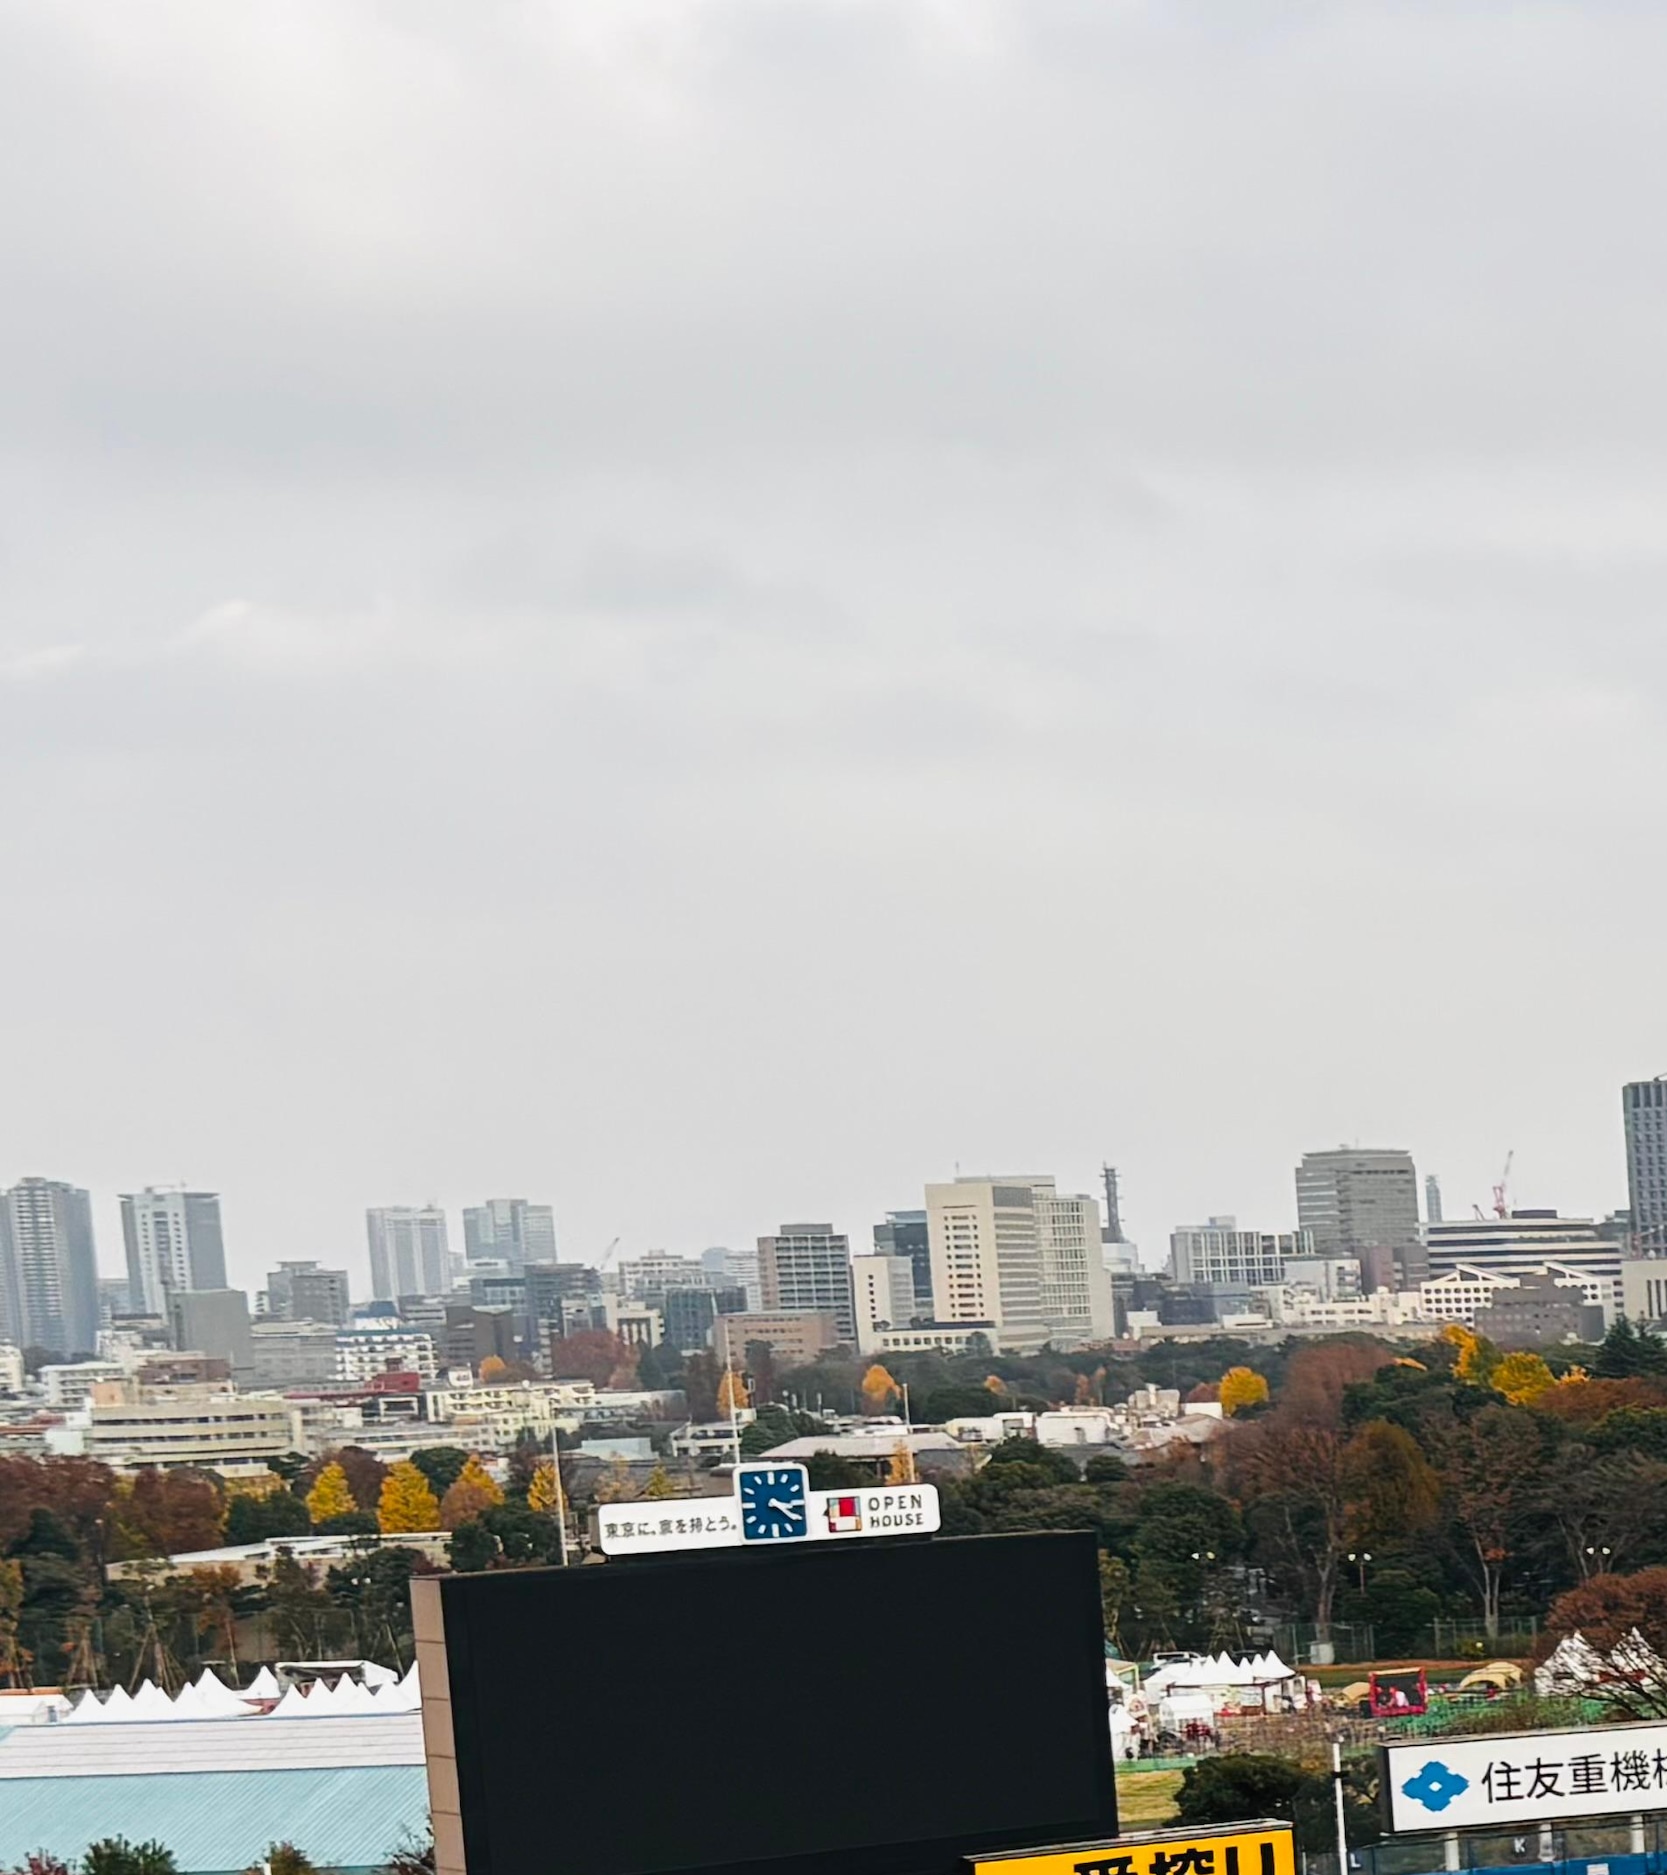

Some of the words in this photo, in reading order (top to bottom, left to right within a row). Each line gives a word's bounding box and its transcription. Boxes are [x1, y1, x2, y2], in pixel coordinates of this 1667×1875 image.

[868, 1494, 923, 1512] OPEN
[870, 1511, 925, 1528] HOUSE
[1514, 1838, 1526, 1853] K
